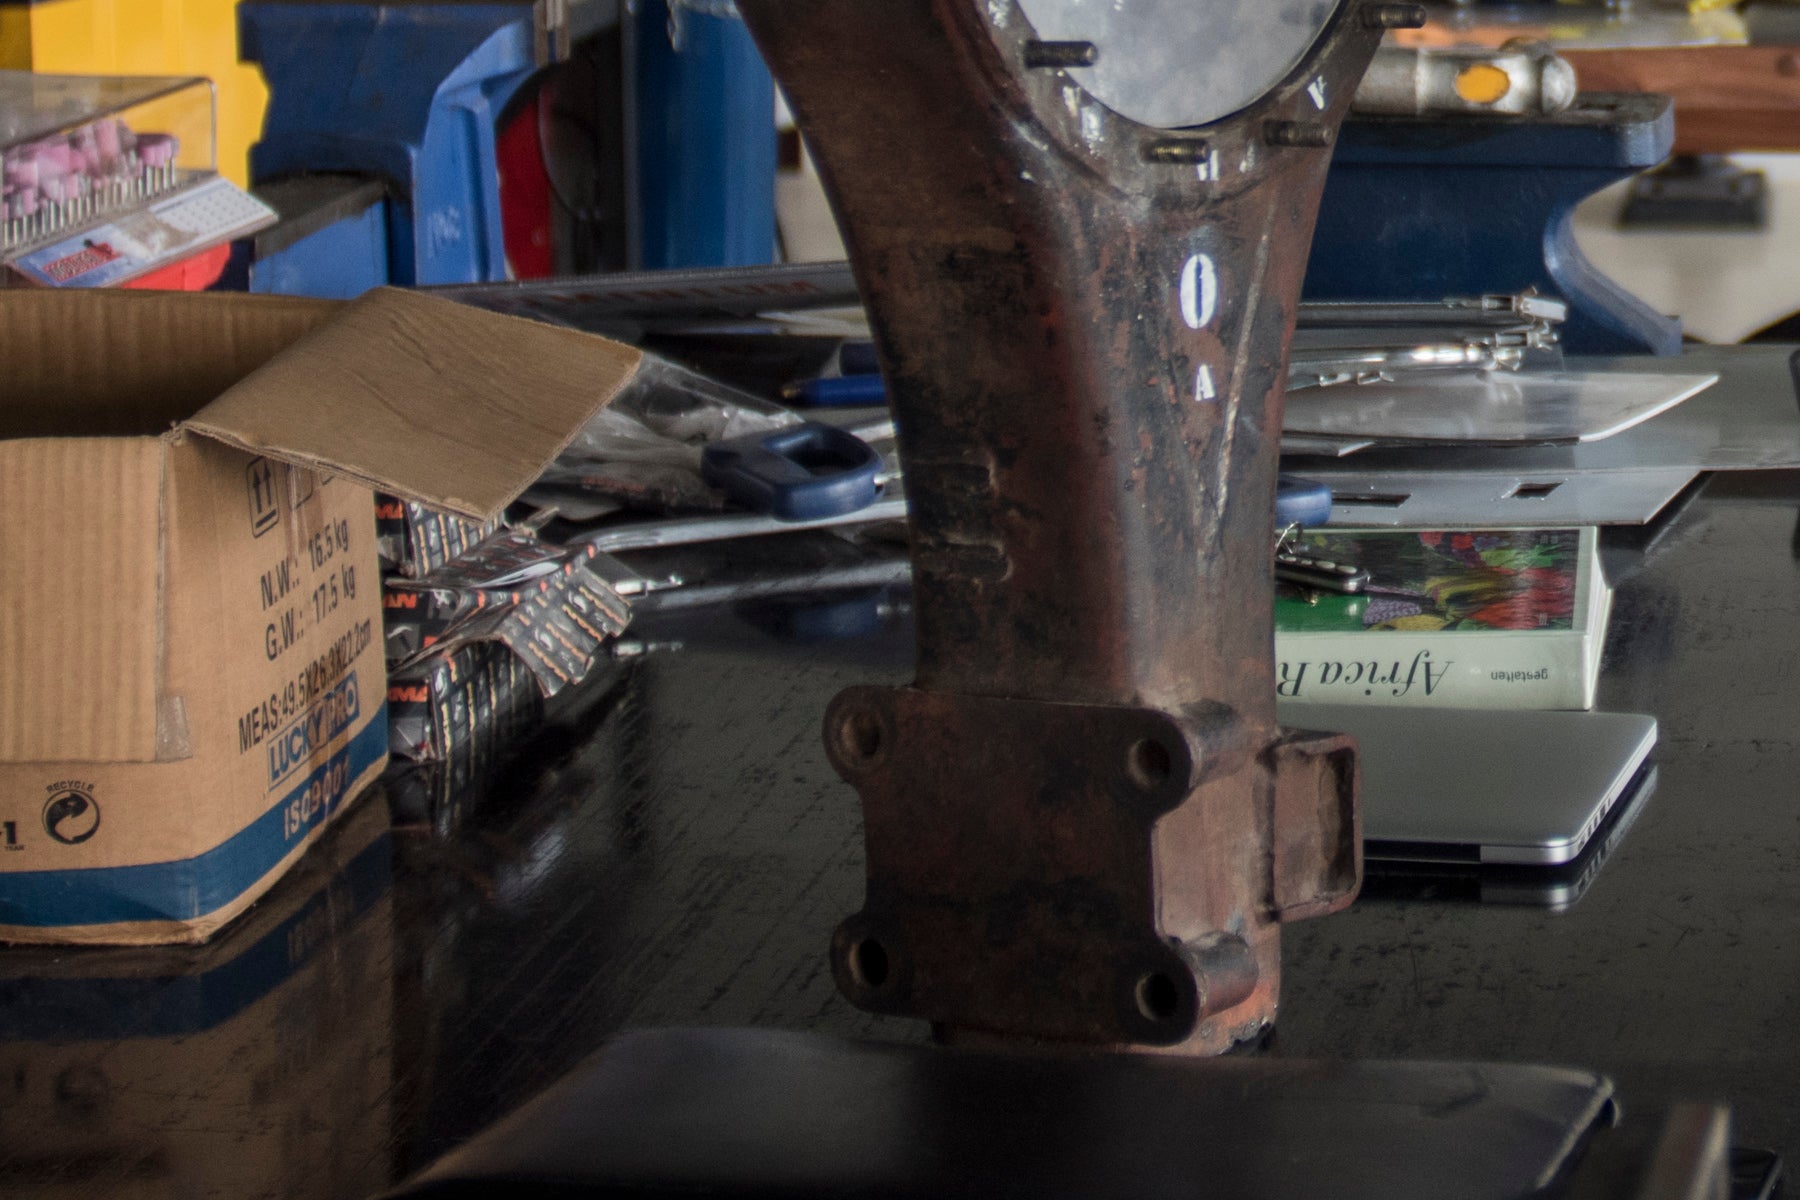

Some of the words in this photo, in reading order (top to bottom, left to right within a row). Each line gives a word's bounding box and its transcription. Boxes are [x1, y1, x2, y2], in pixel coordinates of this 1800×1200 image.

[308, 524, 334, 573] 16.5
[333, 517, 349, 554] kg
[312, 573, 339, 625] 17.5
[341, 563, 356, 601] kg
[1319, 649, 1455, 698] Africa
[1489, 666, 1549, 682] gestalten
[269, 701, 328, 783] LUCKY
[326, 679, 358, 742] PRO
[46, 780, 95, 794] RECYCLE
[283, 753, 350, 841] ISO9001
